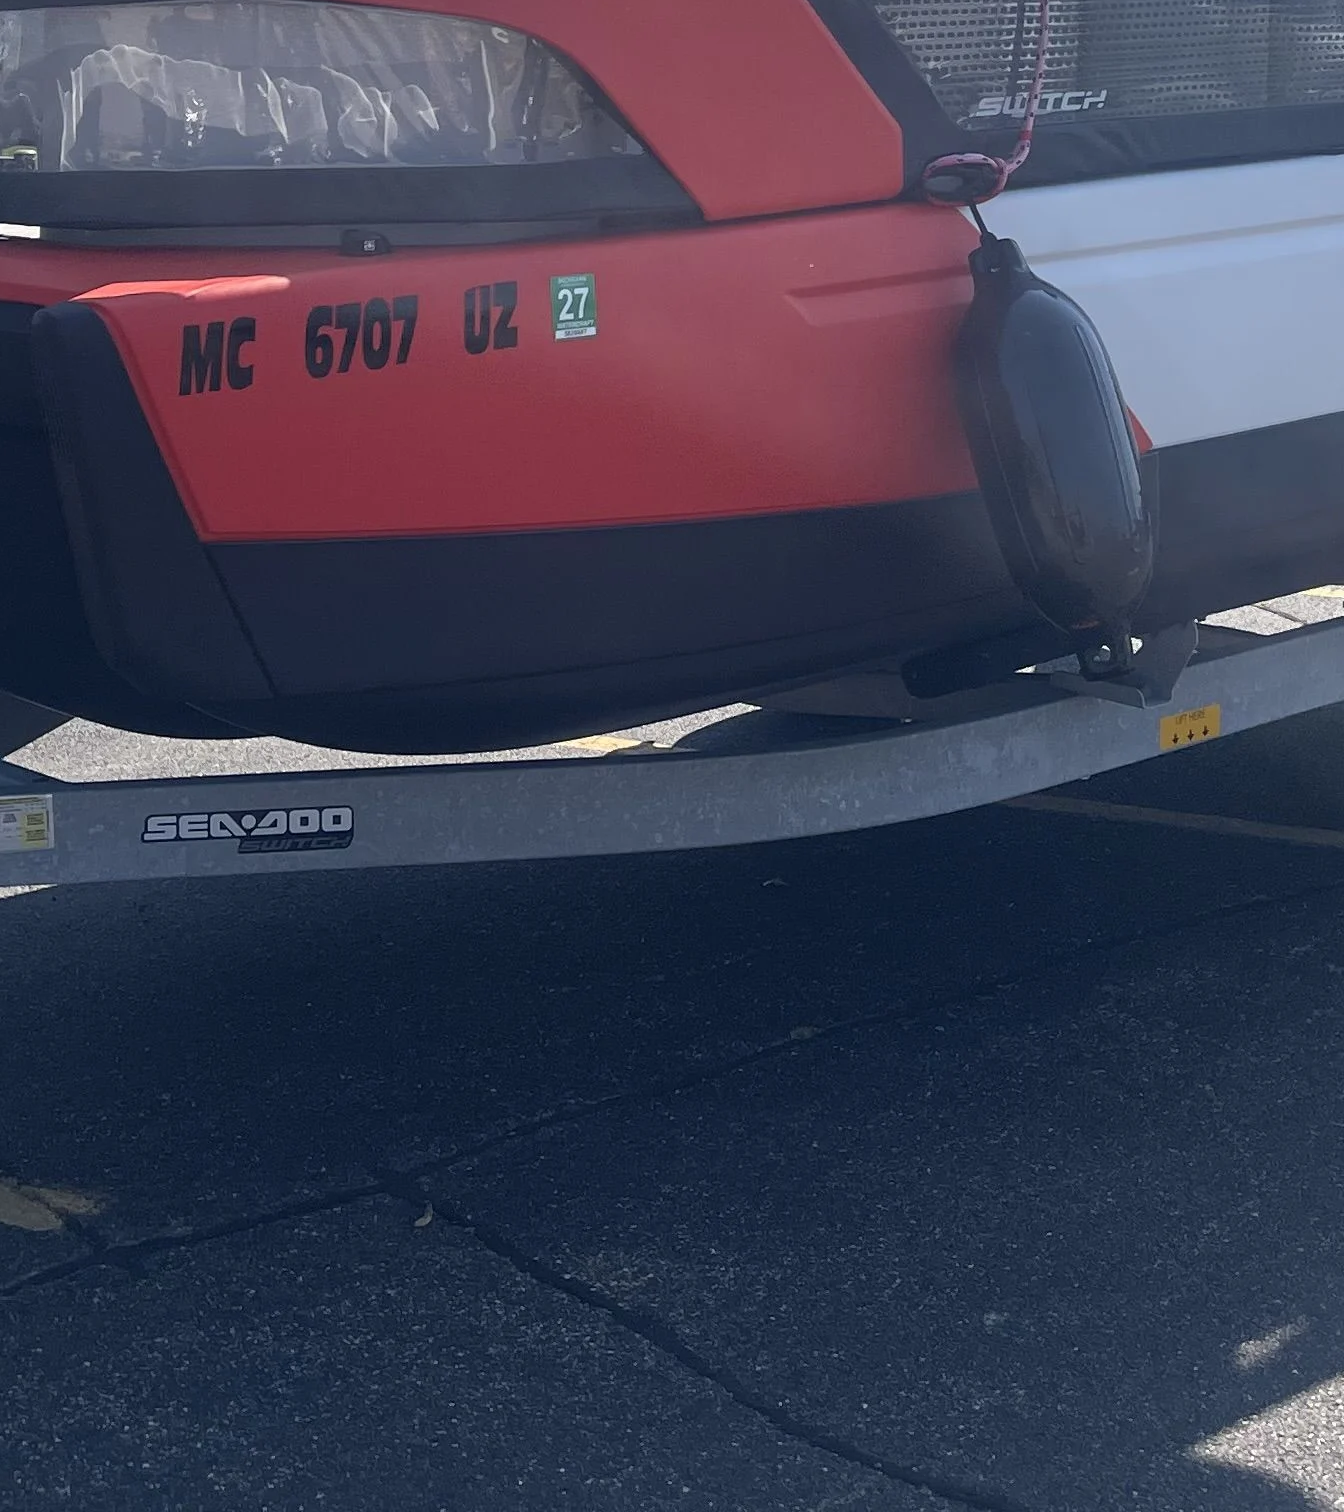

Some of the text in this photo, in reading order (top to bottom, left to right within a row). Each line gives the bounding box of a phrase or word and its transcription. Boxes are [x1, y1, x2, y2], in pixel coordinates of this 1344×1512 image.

[969, 89, 1107, 119] SWTCH
[558, 287, 589, 320] 27
[178, 281, 519, 395] MC 6707 UZ
